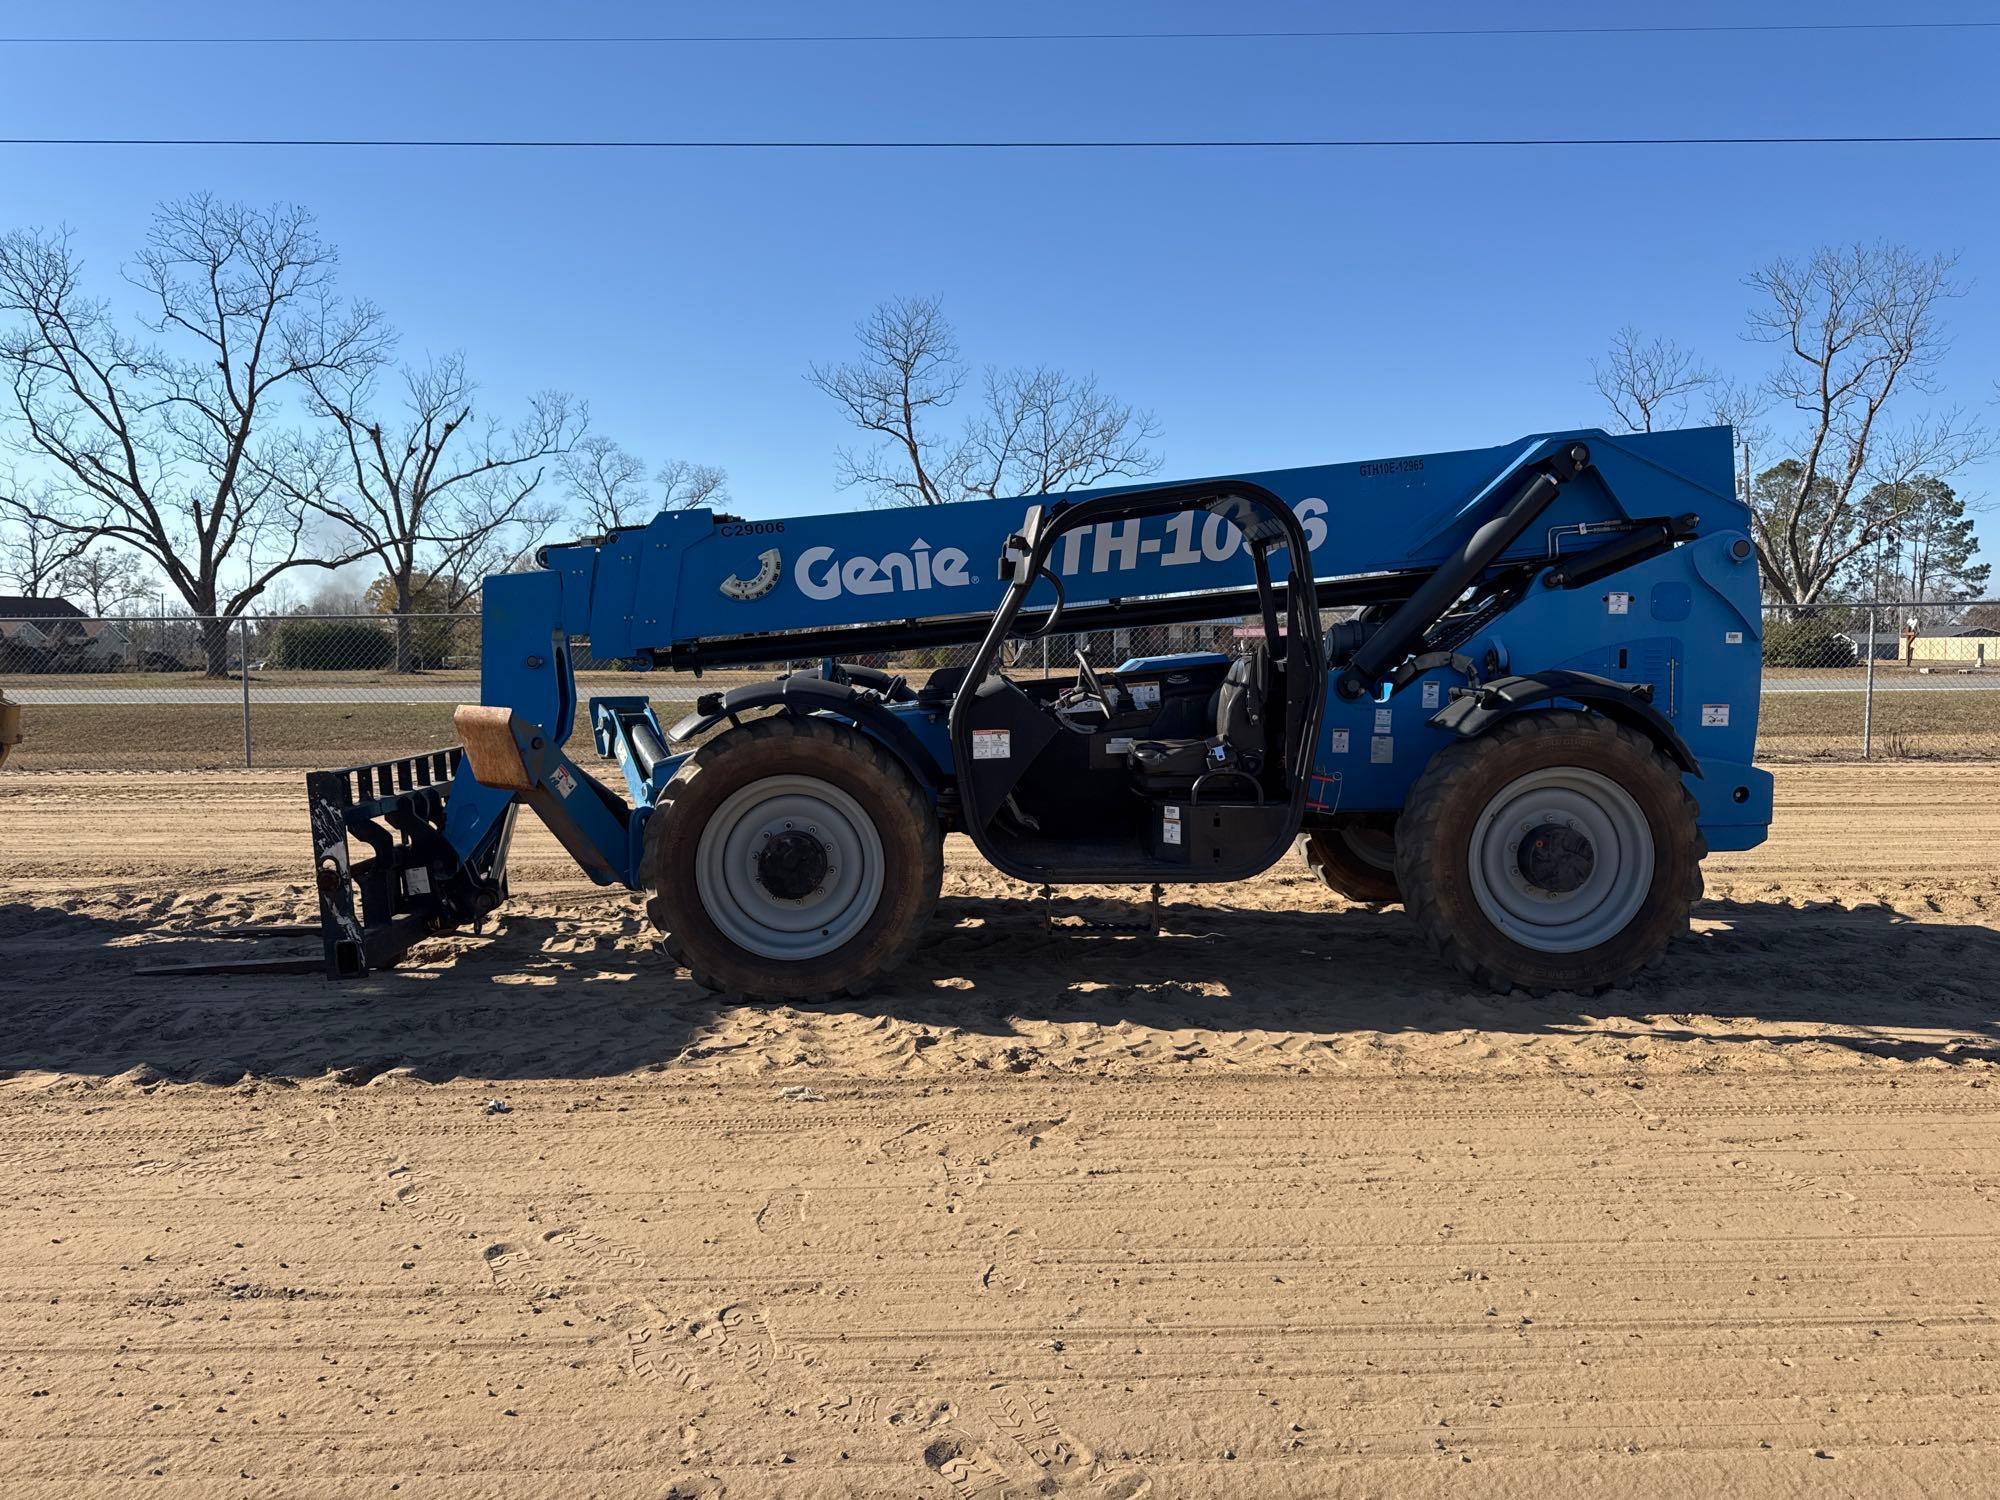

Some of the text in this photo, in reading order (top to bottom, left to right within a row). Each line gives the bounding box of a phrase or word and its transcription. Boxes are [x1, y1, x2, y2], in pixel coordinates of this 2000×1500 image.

[1360, 459, 1424, 477] GTH10E-12965
[721, 521, 785, 537] C29006
[1004, 497, 1329, 578] TH-106
[794, 537, 970, 601] Genie
